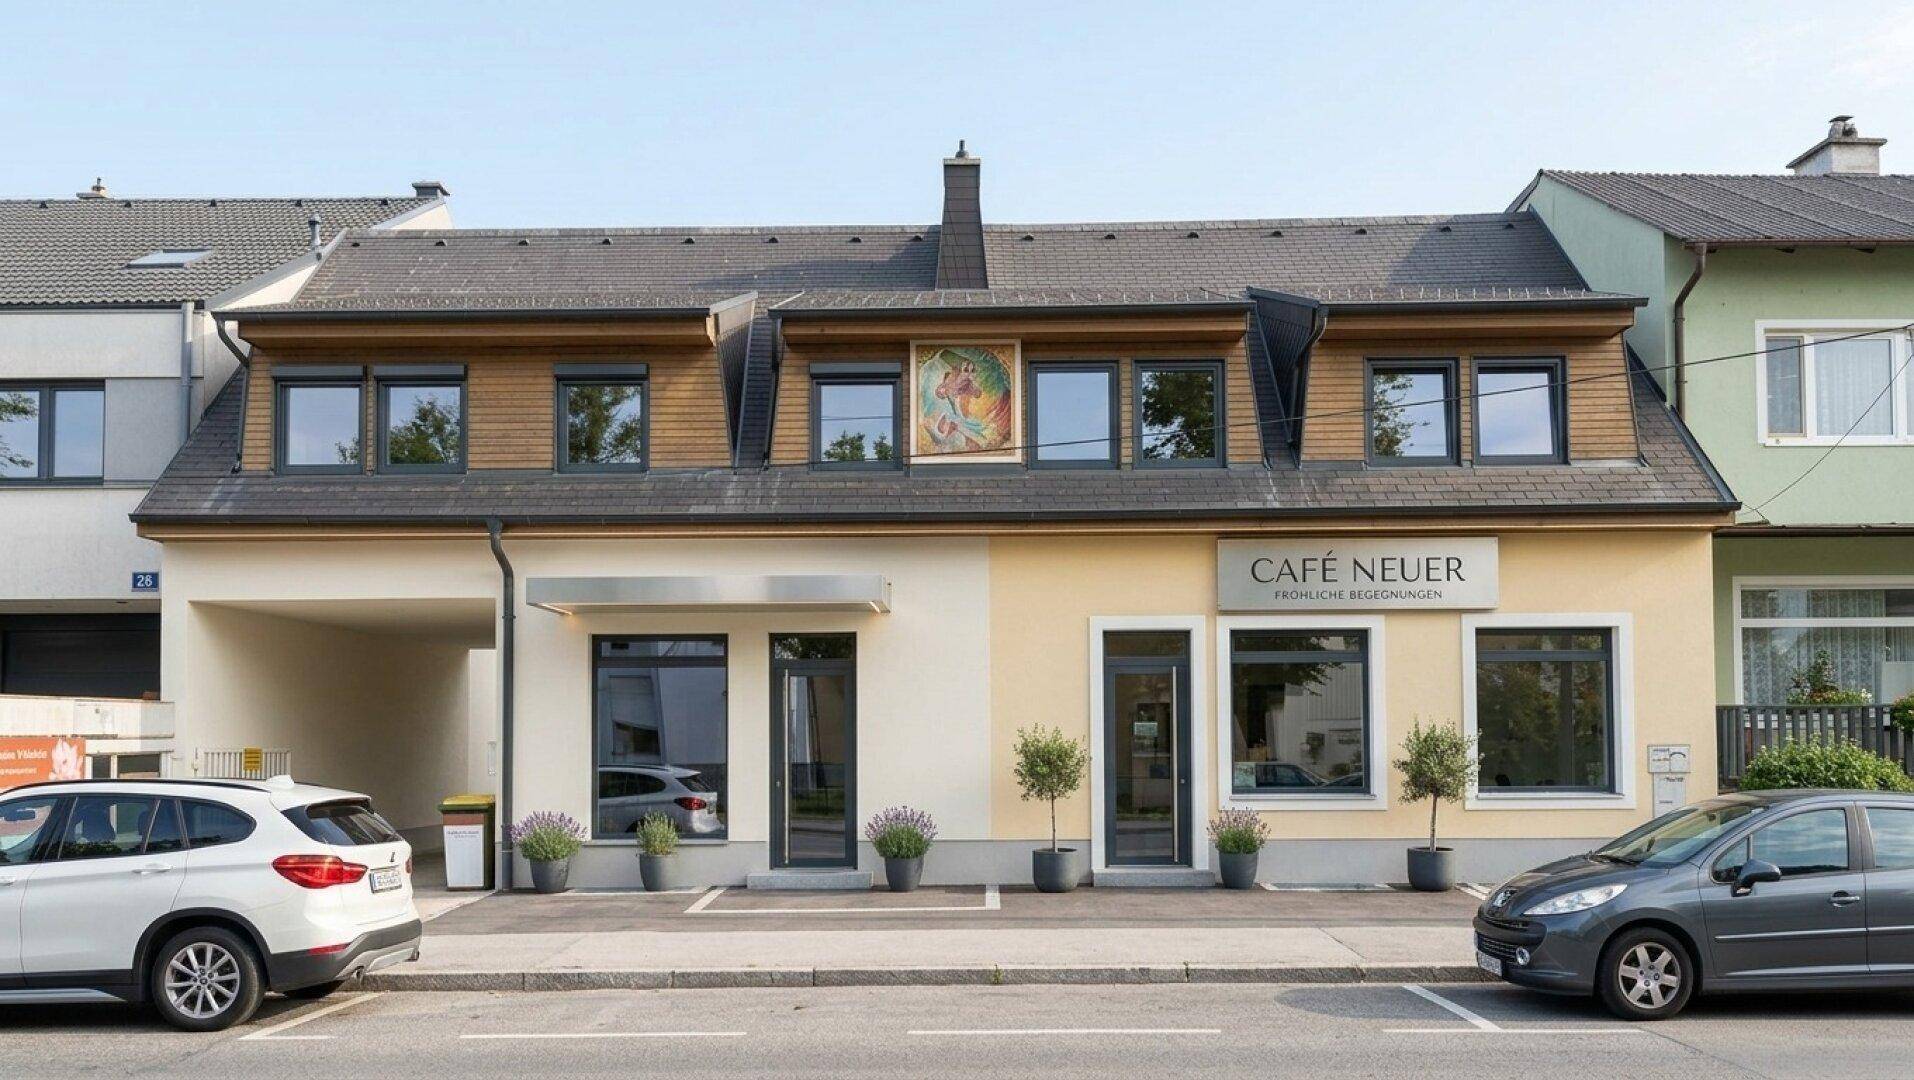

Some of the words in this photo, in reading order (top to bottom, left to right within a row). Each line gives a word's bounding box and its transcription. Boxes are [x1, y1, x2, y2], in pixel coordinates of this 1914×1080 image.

[1251, 550, 1338, 583] CAFÉ
[1353, 557, 1466, 582] NEUER
[1349, 589, 1443, 600] BEGEGNUNGEN
